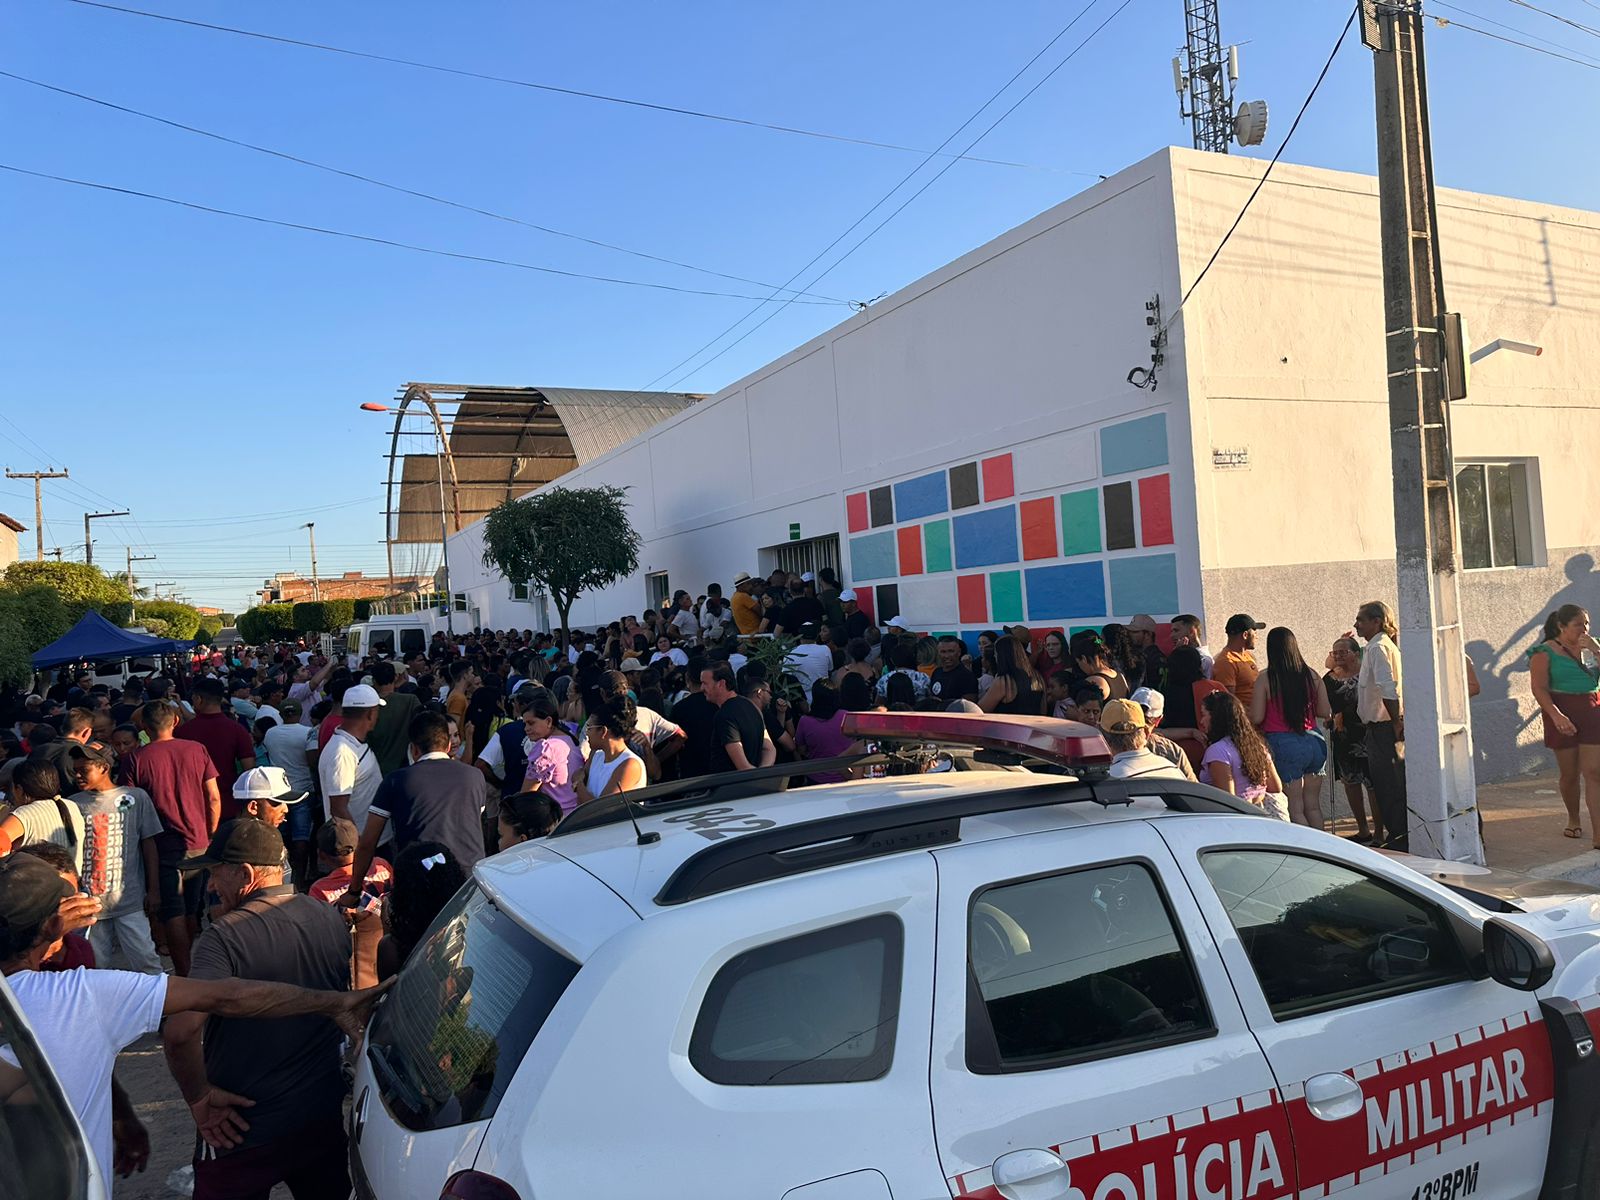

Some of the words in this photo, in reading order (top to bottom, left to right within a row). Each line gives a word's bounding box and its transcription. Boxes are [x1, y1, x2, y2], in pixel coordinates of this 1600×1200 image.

[662, 807, 777, 841] 842
[1069, 1130, 1285, 1200] OLÍCIA
[1365, 1048, 1529, 1155] MILITAR
